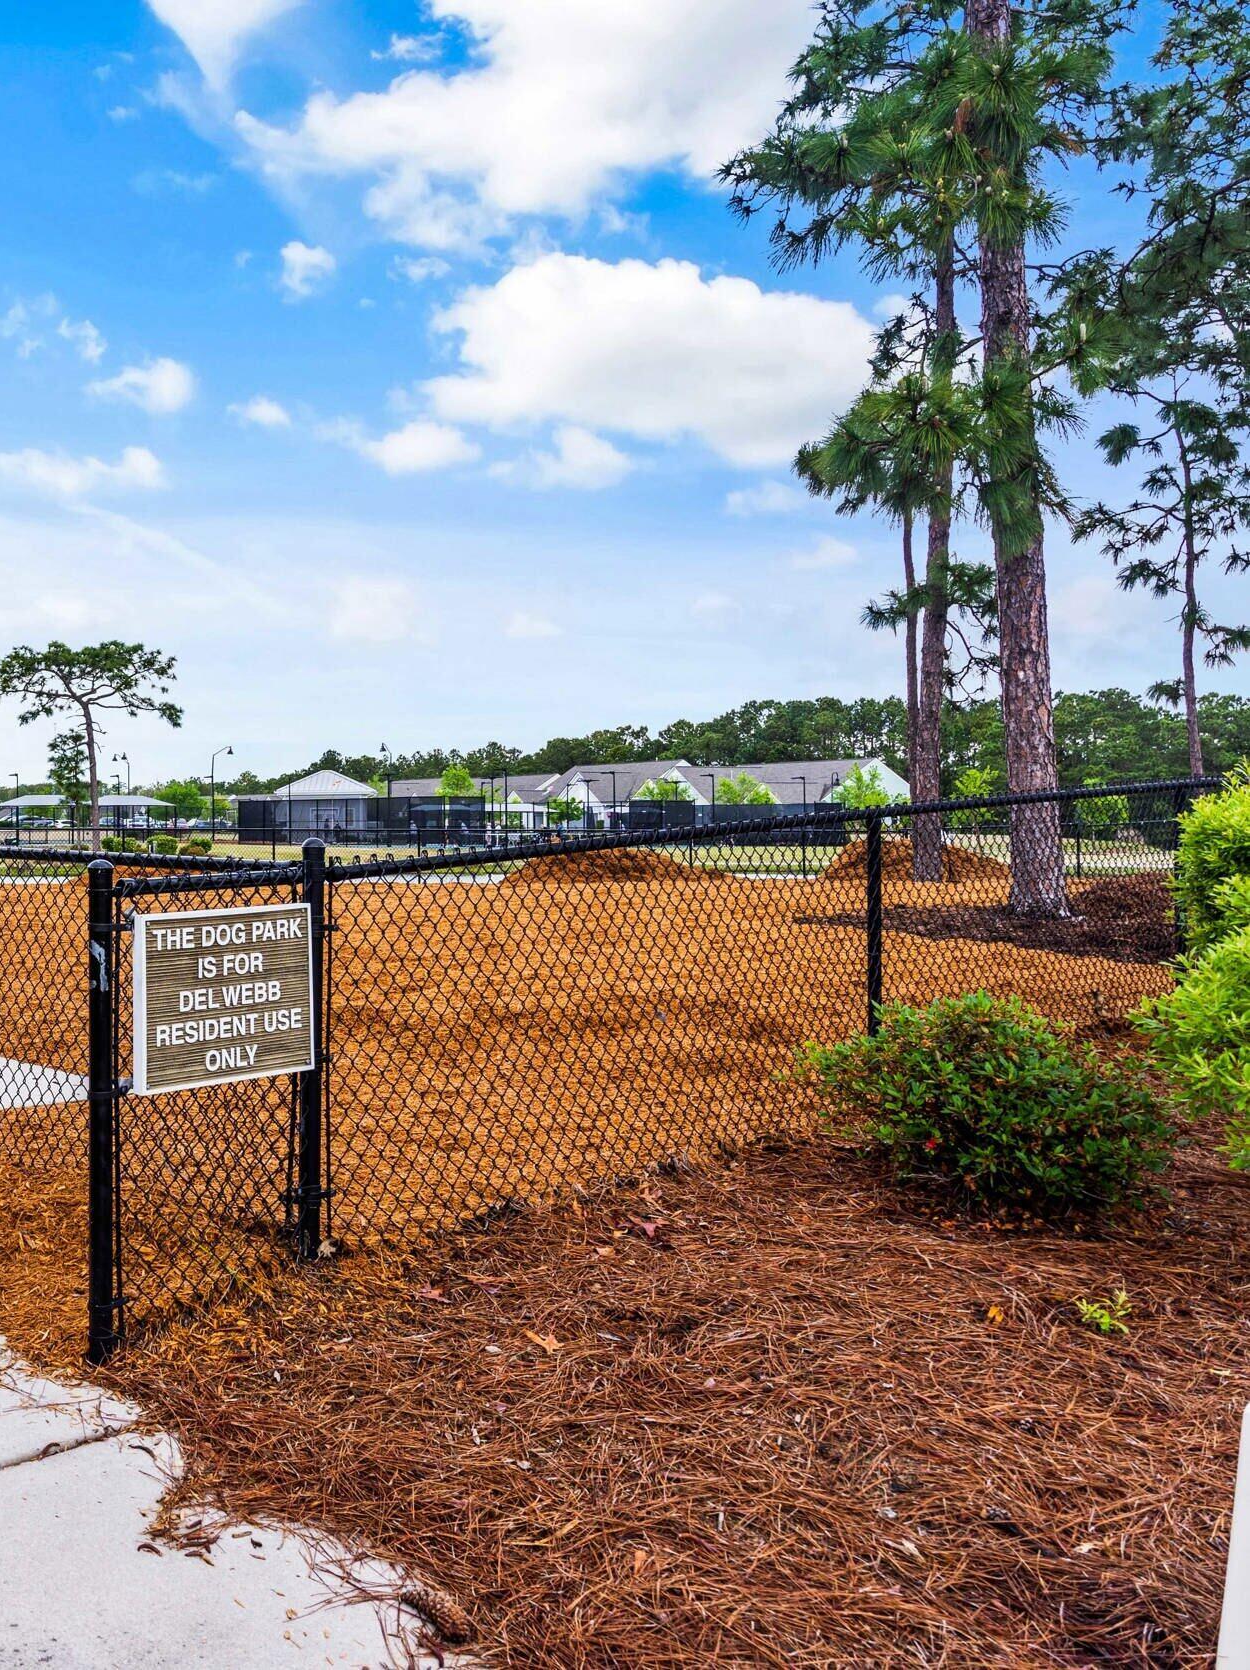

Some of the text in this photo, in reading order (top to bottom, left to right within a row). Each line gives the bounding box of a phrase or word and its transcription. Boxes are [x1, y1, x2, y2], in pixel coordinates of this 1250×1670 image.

[152, 918, 302, 951] THE DOG PARK
[198, 952, 263, 979] IS FOR
[179, 981, 281, 1013] DEL WEBB
[156, 1008, 302, 1048] RESIDENT USE
[205, 1044, 258, 1072] ONLY
